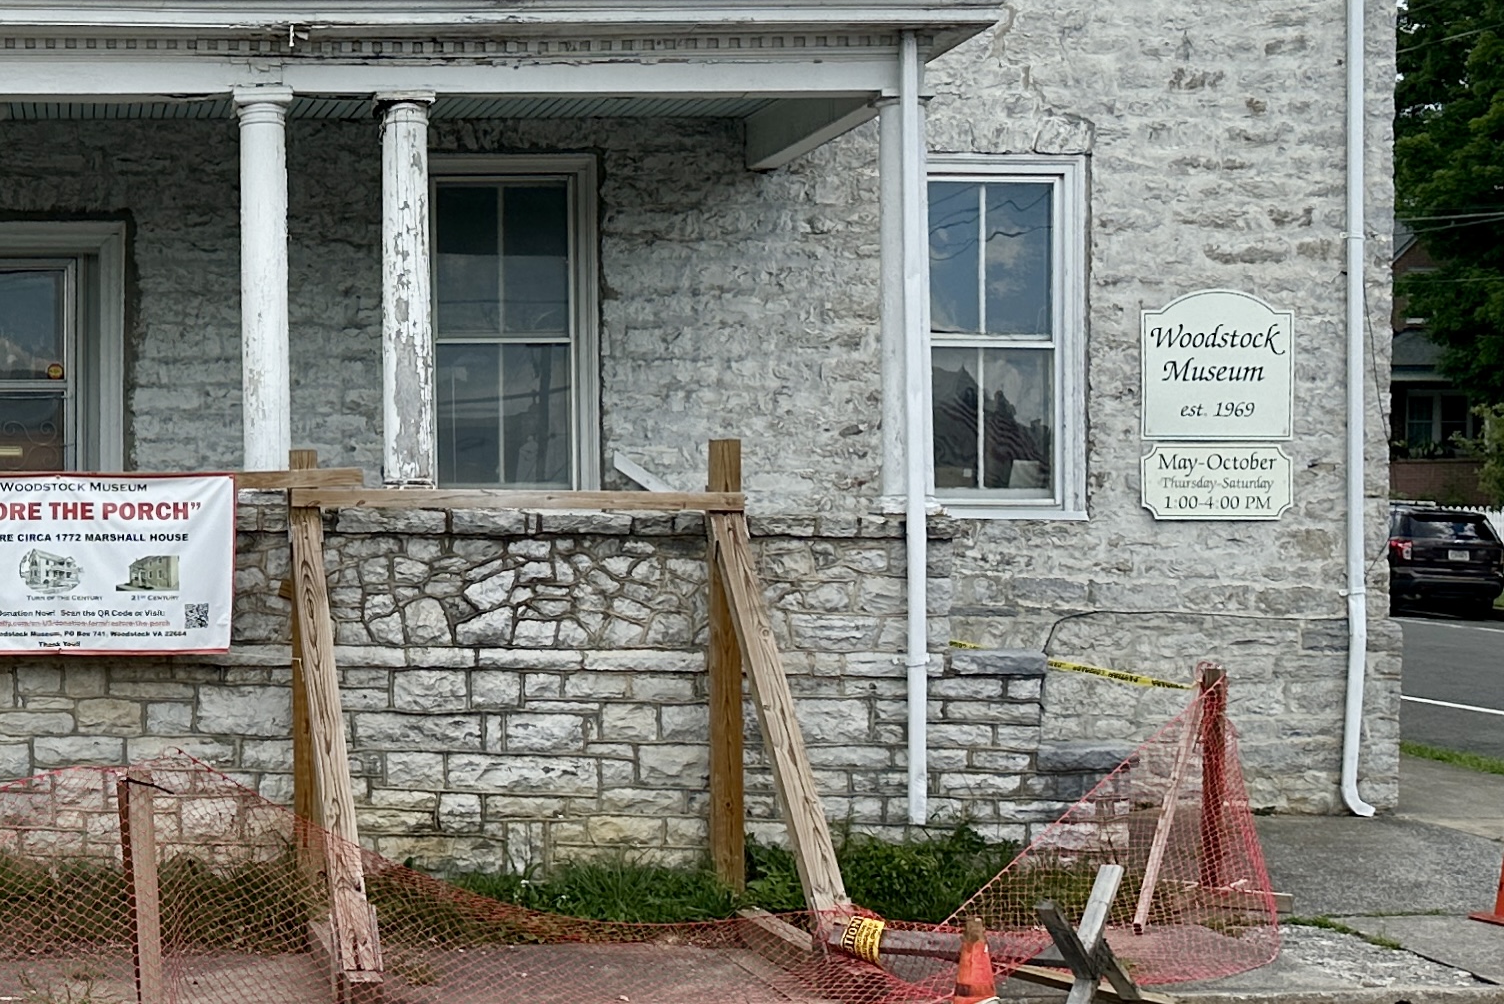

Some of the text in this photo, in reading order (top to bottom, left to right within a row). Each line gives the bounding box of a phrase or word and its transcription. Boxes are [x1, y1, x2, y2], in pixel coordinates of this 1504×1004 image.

[1150, 323, 1286, 355] Woodstock
[1161, 357, 1265, 382] Museum
[1180, 402, 1255, 417] est. 1969
[1157, 452, 1278, 477] May-October
[0, 482, 86, 492] WOODSTOCK
[90, 482, 147, 492] MUSEUM
[1246, 495, 1272, 510] PM
[49, 502, 94, 520] THE
[17, 533, 52, 542] CIRCA
[55, 533, 82, 542] 1772
[85, 533, 146, 542] MARSHALL
[150, 533, 189, 542] HOUSE
[97, 609, 110, 617] QR
